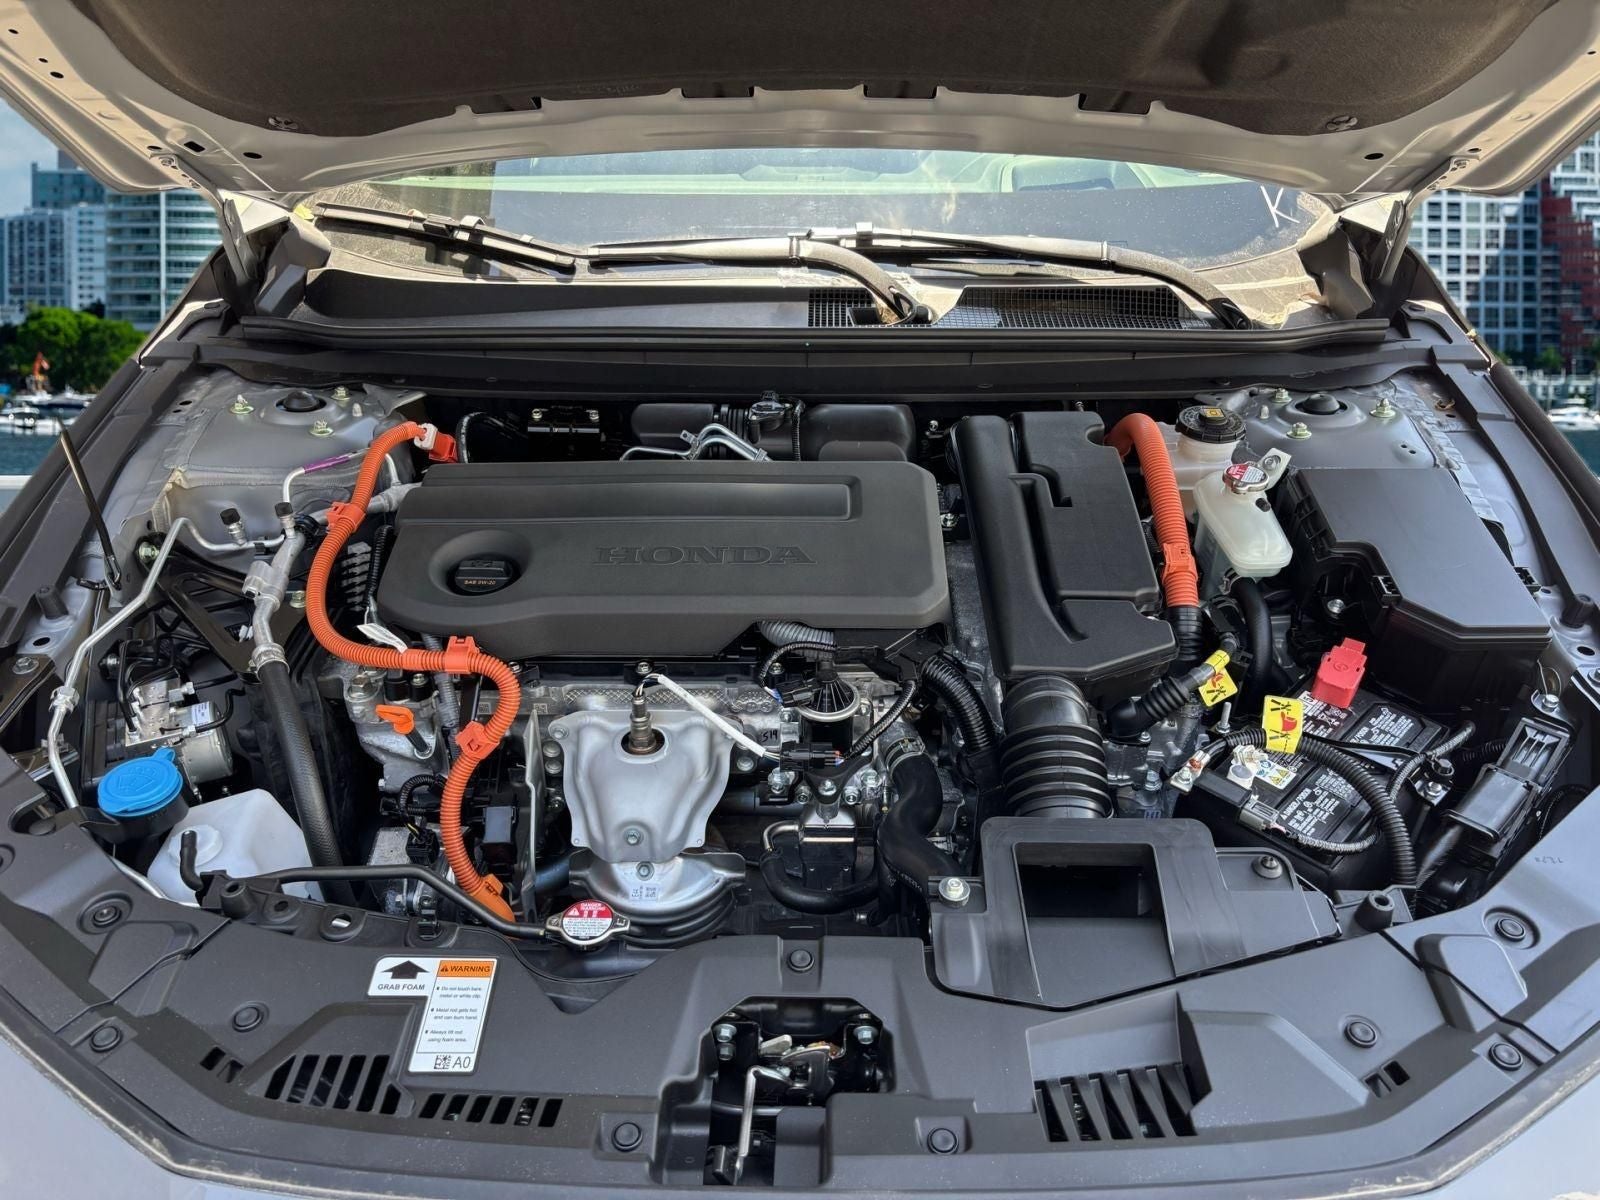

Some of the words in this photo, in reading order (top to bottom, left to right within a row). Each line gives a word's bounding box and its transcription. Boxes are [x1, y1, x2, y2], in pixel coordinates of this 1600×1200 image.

[593, 545, 817, 565] HONDA
[450, 965, 490, 973] WARNING
[377, 983, 401, 991] GRAB
[401, 983, 426, 991] FOAM
[451, 1056, 471, 1069] A0
